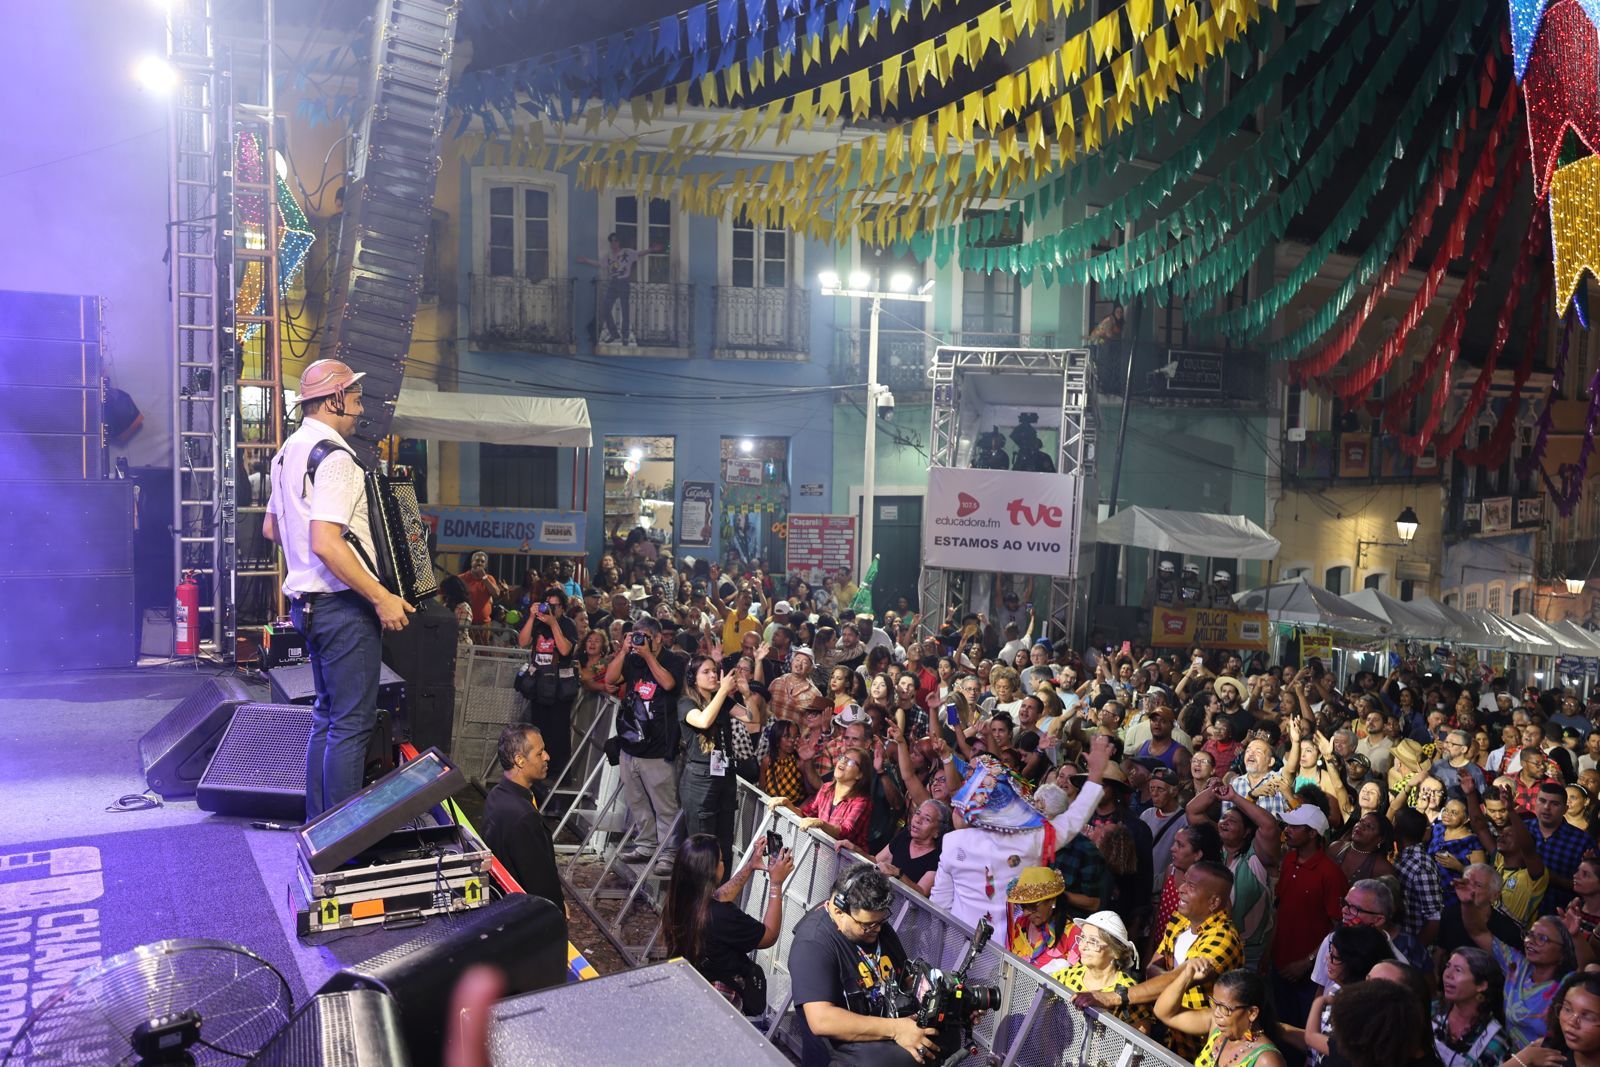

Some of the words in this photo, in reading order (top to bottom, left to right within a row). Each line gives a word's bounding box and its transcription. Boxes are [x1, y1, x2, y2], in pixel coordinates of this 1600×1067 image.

[935, 516, 1000, 528] educadora.fm
[1006, 498, 1063, 528] tve
[934, 535, 999, 549] ESTAMOS
[1003, 540, 1023, 551] AO
[1027, 541, 1061, 553] VIVO
